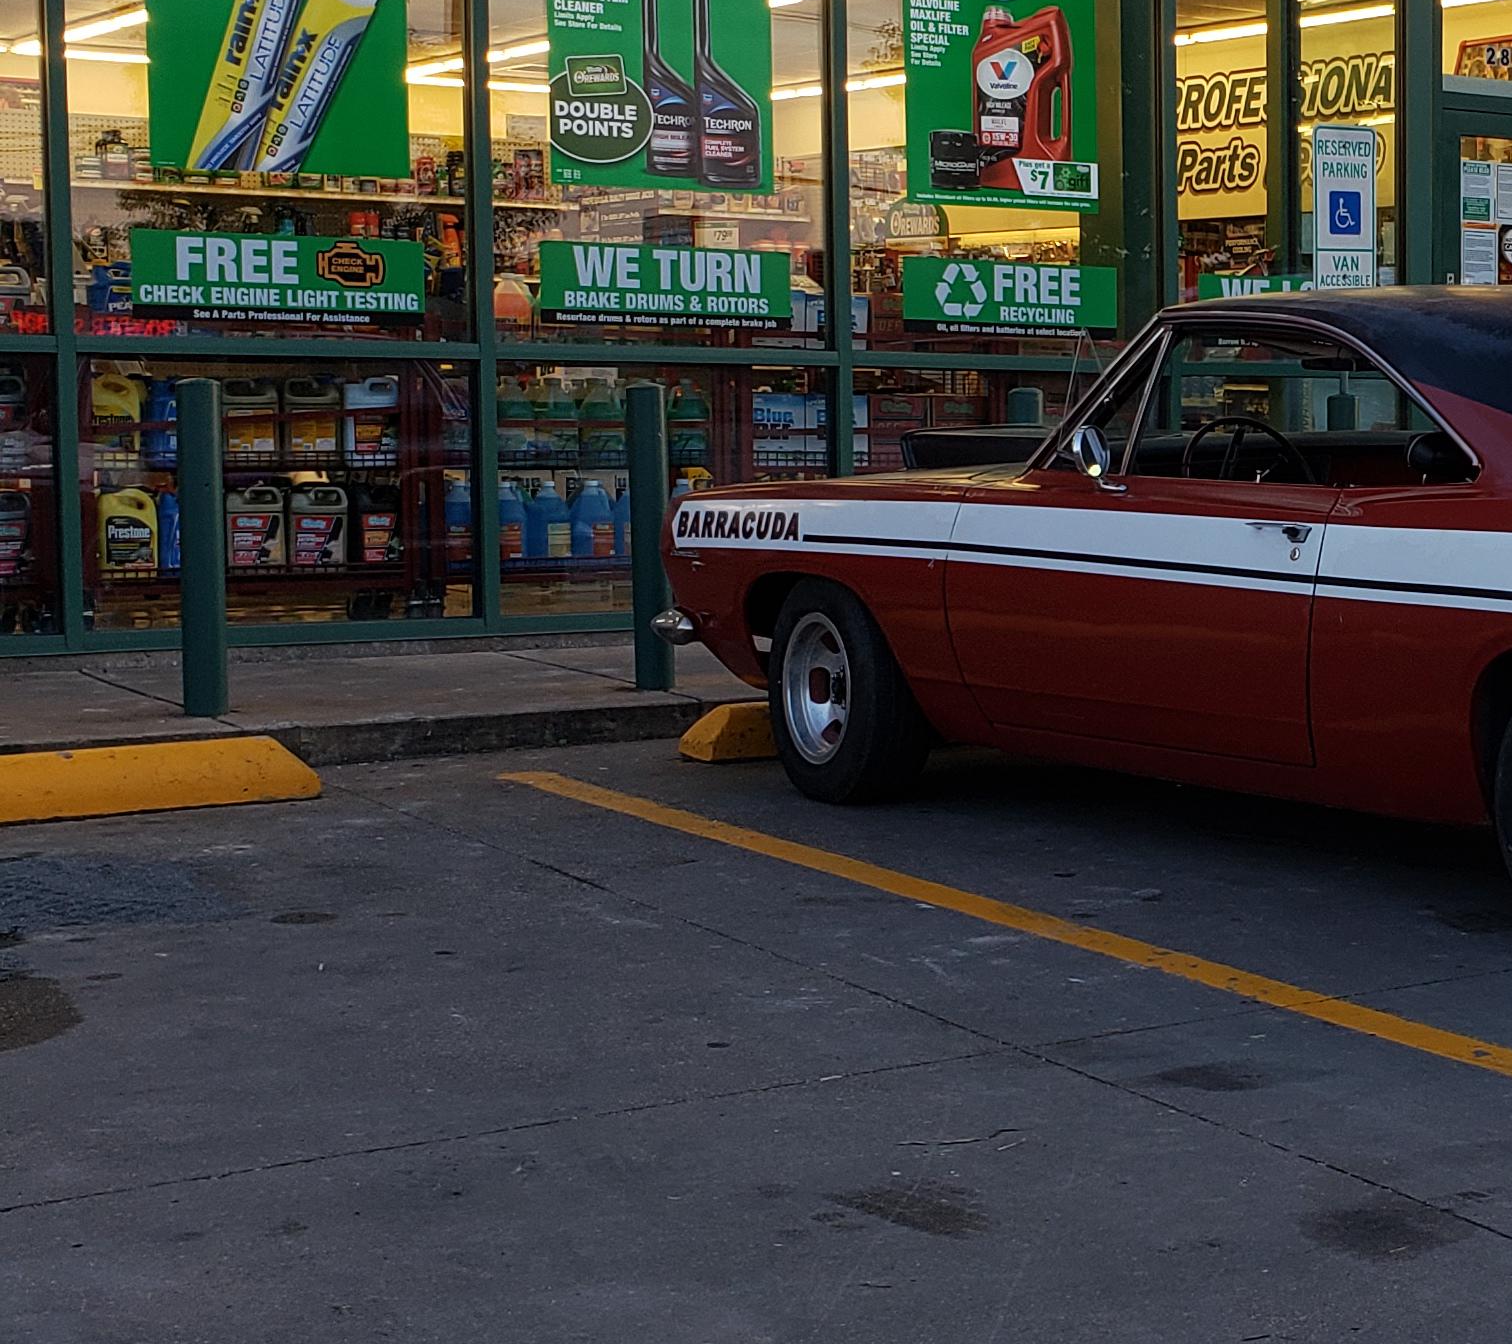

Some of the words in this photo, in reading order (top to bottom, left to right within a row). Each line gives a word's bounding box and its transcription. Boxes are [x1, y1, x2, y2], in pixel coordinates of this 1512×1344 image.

[554, 0, 604, 14] CLEANER
[910, 9, 952, 22] MAXLIFE
[910, 20, 926, 31] OIL
[928, 22, 937, 33] &
[939, 23, 969, 36] FILTER
[910, 34, 950, 46] SPECIAL
[289, 35, 343, 129] LATITUDE
[554, 100, 638, 121] DOUBLE
[559, 119, 634, 138] POINTS
[703, 116, 752, 132] TECHRON
[1317, 139, 1371, 157] RESERVED
[1178, 142, 1258, 189] Parts
[1322, 161, 1368, 179] PARKING
[1030, 169, 1050, 190] $7
[176, 236, 299, 284] FREE
[331, 257, 363, 266] CHECK
[1332, 256, 1359, 272] VAN
[331, 265, 364, 274] ENGINE
[573, 246, 641, 288] WE
[653, 249, 761, 293] TURN
[993, 264, 1081, 306] FREE
[1320, 274, 1371, 287] ACCESSIBLE
[140, 285, 204, 304] CHECK
[211, 287, 280, 306] ENGINE
[287, 289, 337, 308] LIGHT
[344, 291, 418, 311] TESTING
[564, 290, 620, 308] BRAKE
[626, 293, 685, 311] DRUMS
[690, 296, 702, 312] &
[707, 296, 769, 314] ROTORS
[193, 309, 210, 319] See
[212, 310, 219, 319] A
[221, 310, 245, 320] Parts
[248, 311, 304, 321] Professional
[306, 312, 320, 322] For
[323, 313, 370, 324] Assistance
[556, 312, 596, 322] Resurface
[599, 313, 624, 323] drums
[634, 315, 656, 324] rotors
[671, 316, 687, 326] part
[688, 317, 697, 325] of
[705, 318, 740, 328] complete
[742, 319, 763, 328] brake
[765, 320, 777, 329] job
[1000, 306, 1075, 324] RECYCLING
[936, 323, 948, 332] Oil,
[960, 324, 980, 333] filters
[982, 325, 994, 333] and
[996, 325, 1025, 335] batteries
[1027, 326, 1035, 335] at
[1036, 327, 1055, 336] select
[754, 407, 794, 424] Blue
[108, 524, 151, 541] Prestone
[677, 510, 800, 542] BARRACUDA
